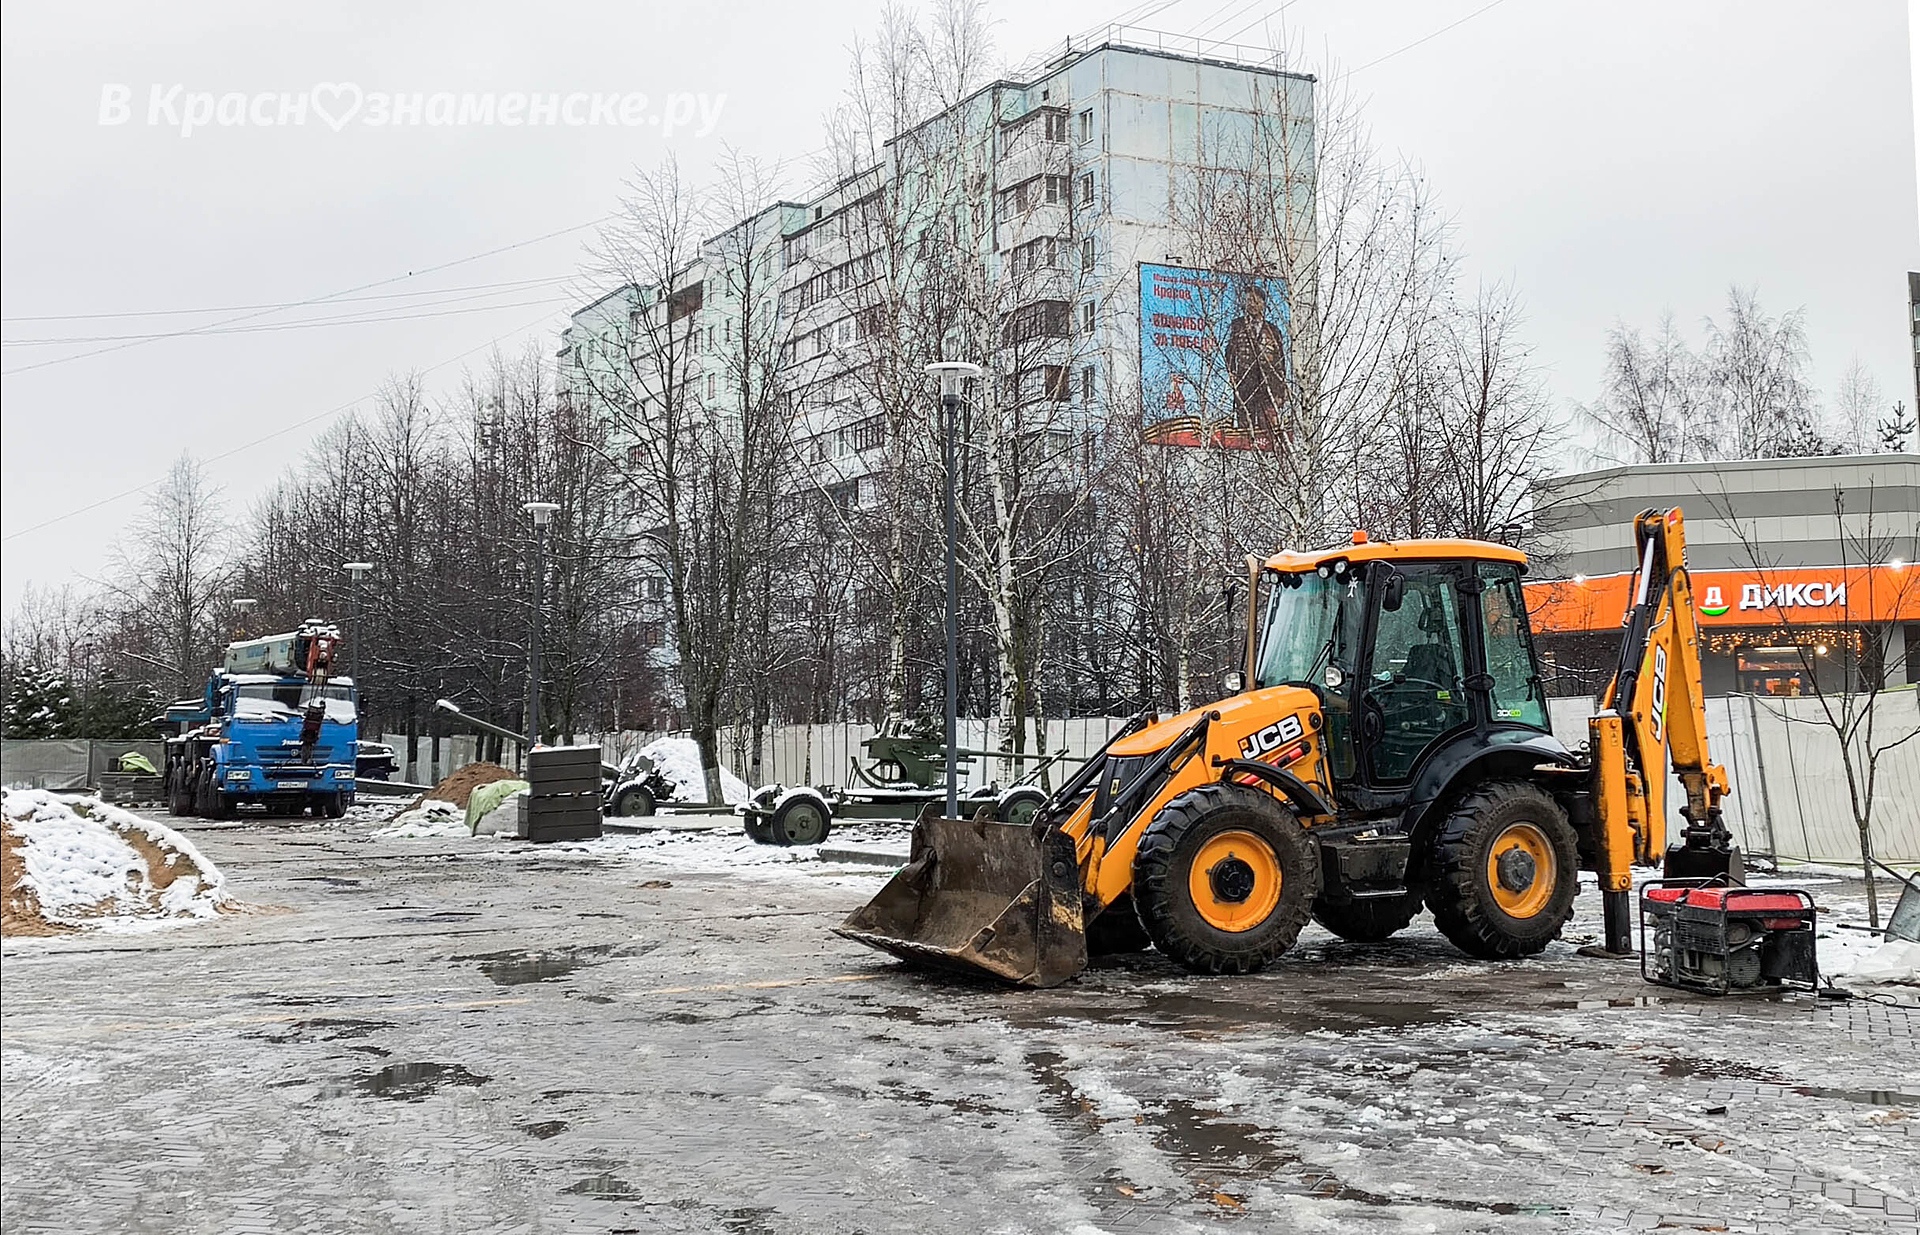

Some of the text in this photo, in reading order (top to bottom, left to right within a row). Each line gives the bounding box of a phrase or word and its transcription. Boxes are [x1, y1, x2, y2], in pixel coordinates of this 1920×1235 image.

[1154, 332, 1168, 348] ЗА
[1739, 582, 1847, 610] ДИКСИ
[1651, 644, 1667, 741] JCB
[1242, 715, 1302, 760] JCB
